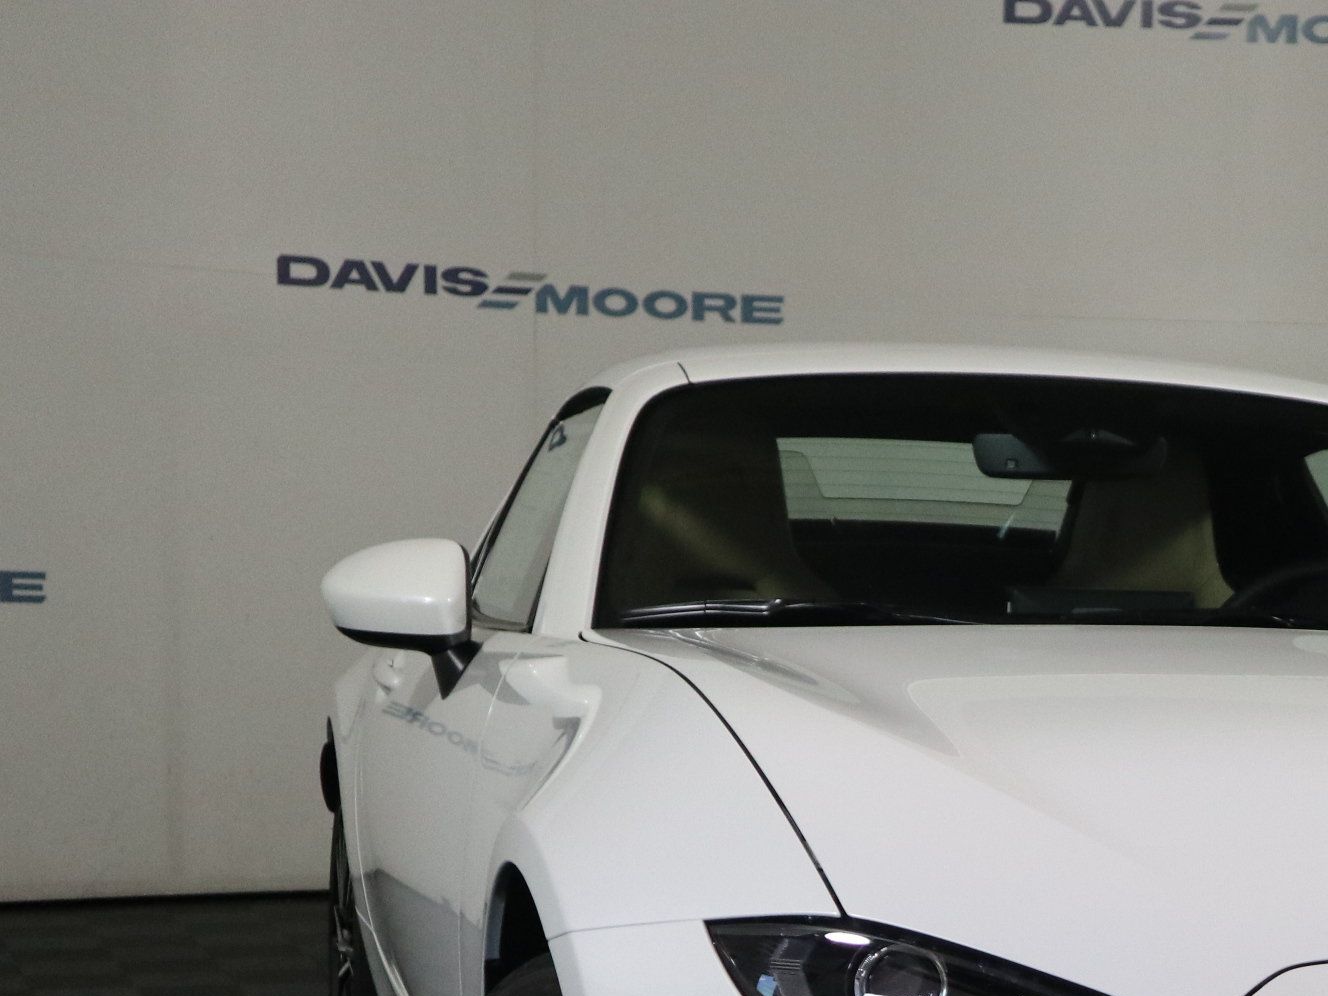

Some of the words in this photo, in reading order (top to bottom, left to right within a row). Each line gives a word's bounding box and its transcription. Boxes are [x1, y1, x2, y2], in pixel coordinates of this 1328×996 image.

[1002, 0, 1203, 30] DAVIS
[277, 253, 490, 299] DAVIS
[534, 284, 786, 326] MOORE
